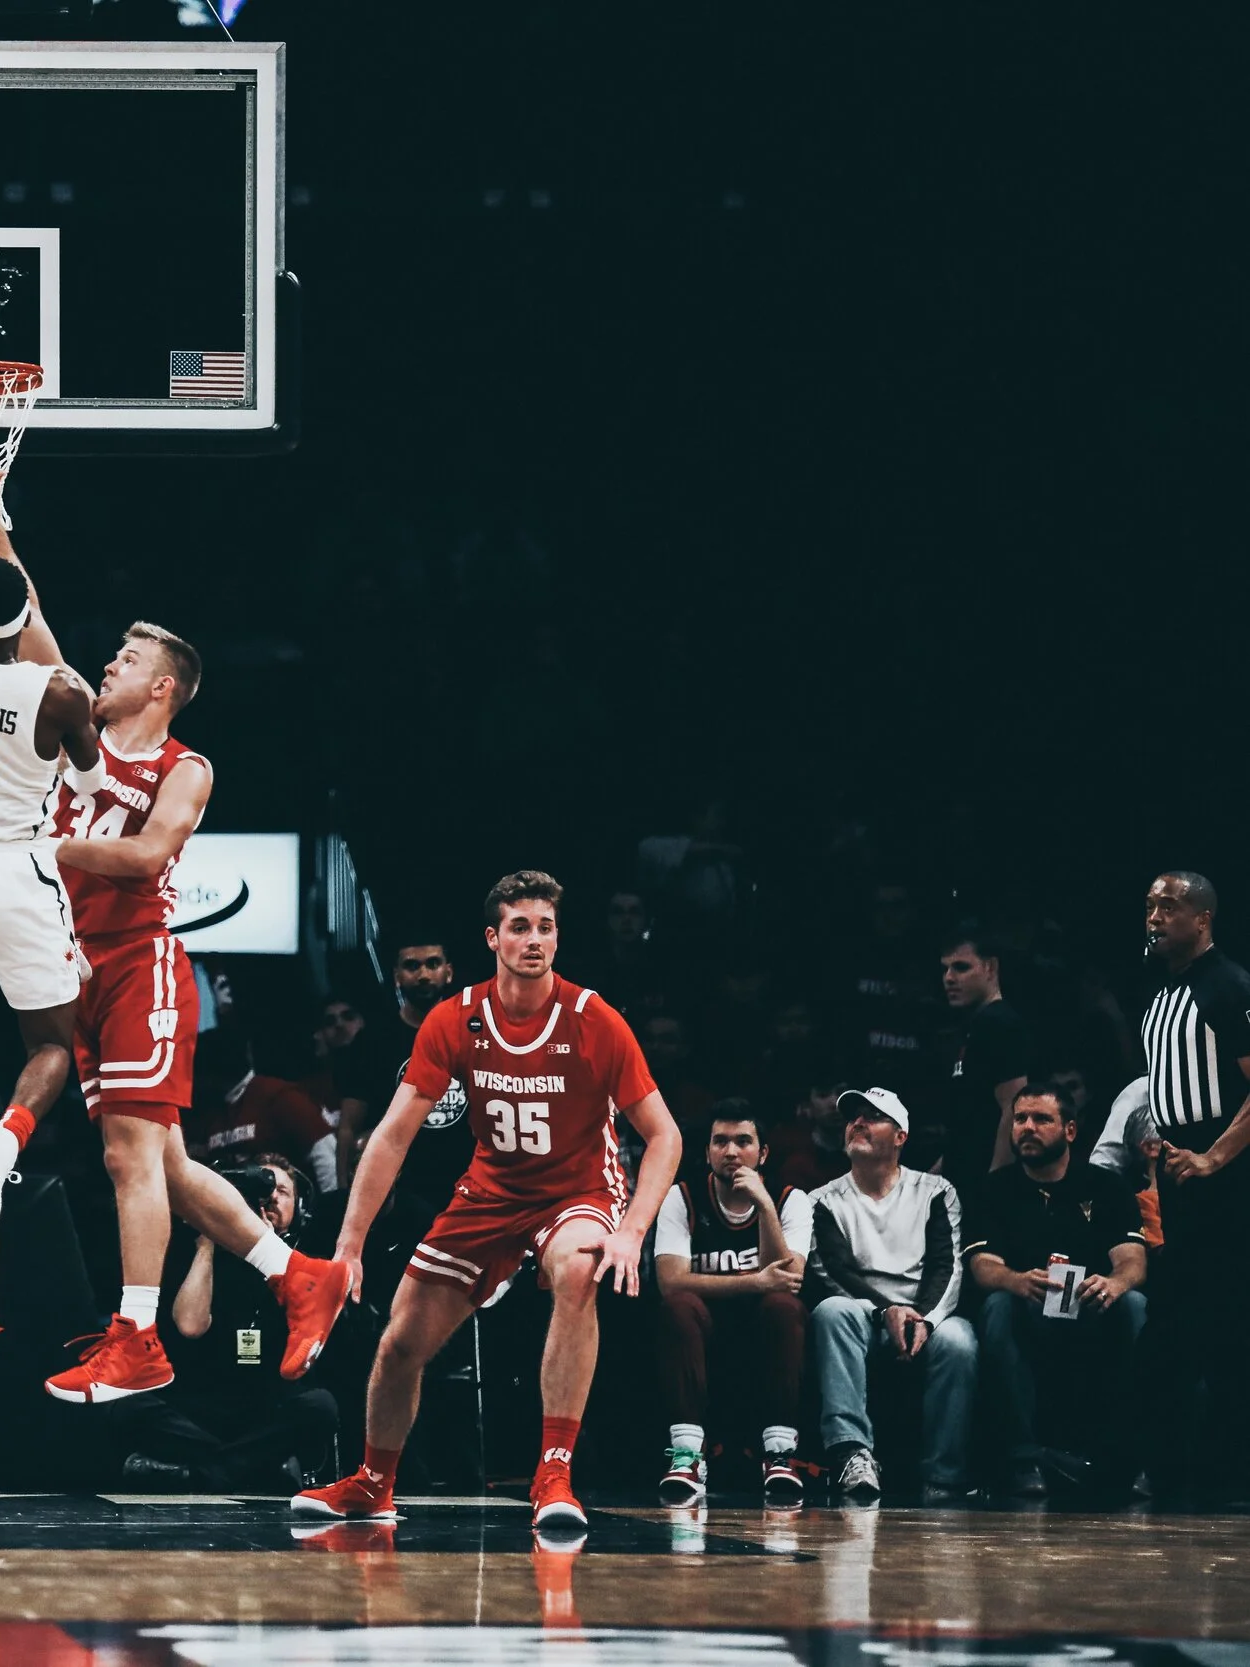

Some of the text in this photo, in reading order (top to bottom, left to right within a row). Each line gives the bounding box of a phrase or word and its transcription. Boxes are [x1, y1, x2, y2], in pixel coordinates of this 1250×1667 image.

[102, 775, 151, 812] ONSIN
[473, 1069, 566, 1094] WISCONSIN
[485, 1099, 552, 1156] 35
